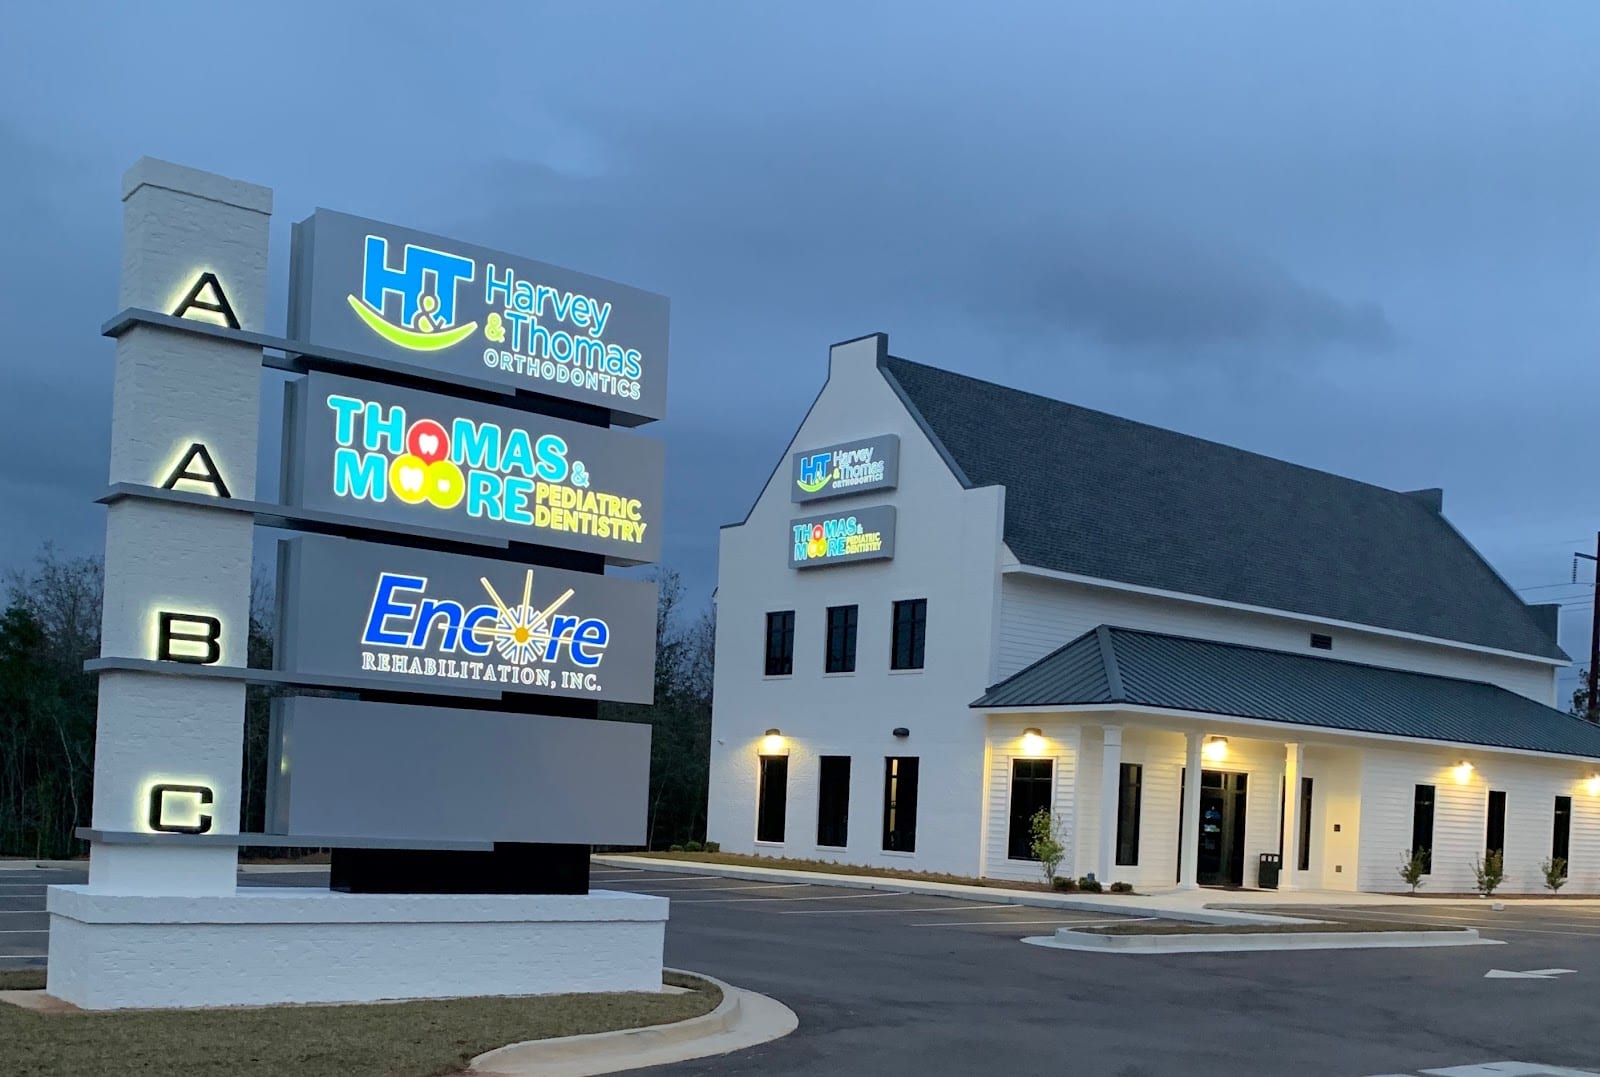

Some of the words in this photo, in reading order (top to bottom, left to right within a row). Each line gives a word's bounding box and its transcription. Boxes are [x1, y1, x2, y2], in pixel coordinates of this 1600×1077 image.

[171, 272, 241, 330] A
[485, 263, 612, 337] Harvey
[483, 348, 641, 400] ORTHODONTICS
[327, 394, 568, 482] THOMAS
[833, 447, 874, 467] Harvey
[161, 443, 231, 498] A
[333, 447, 535, 526] MOORE
[534, 505, 647, 543] DENTISTRY
[535, 481, 642, 521] PEDIATRIC
[793, 516, 857, 542] THOMAS
[794, 536, 846, 561] MOORE
[158, 611, 221, 664] B
[361, 571, 609, 668] Encore
[361, 652, 556, 689] REHABILITATION,
[560, 671, 602, 692] INC.
[149, 784, 213, 834] C
